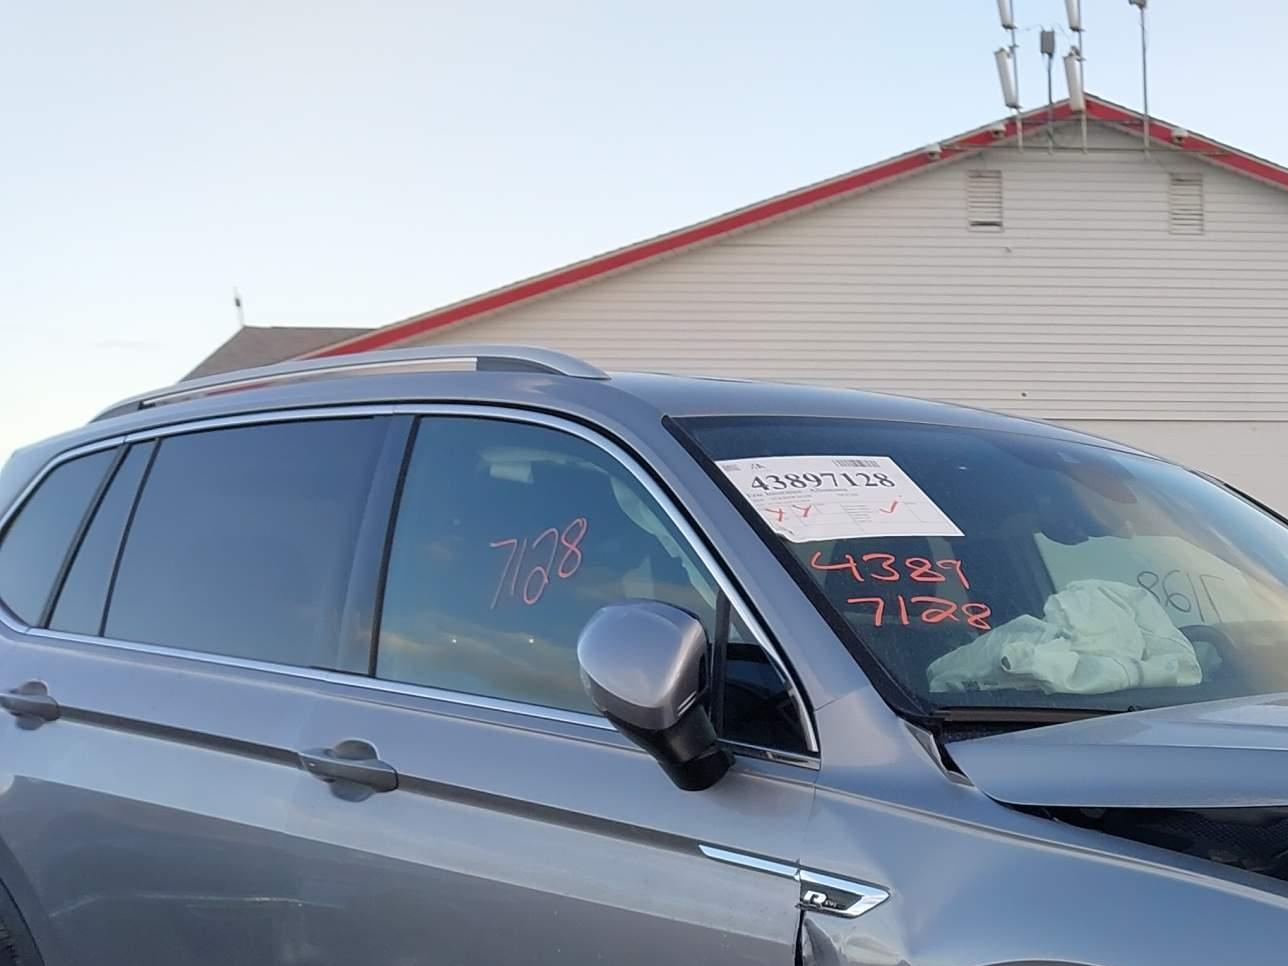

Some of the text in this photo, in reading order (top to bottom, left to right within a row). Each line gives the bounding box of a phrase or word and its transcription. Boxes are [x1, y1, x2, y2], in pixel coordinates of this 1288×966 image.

[751, 472, 896, 491] 43897128
[489, 517, 588, 610] 7128
[847, 594, 992, 630] 7128
